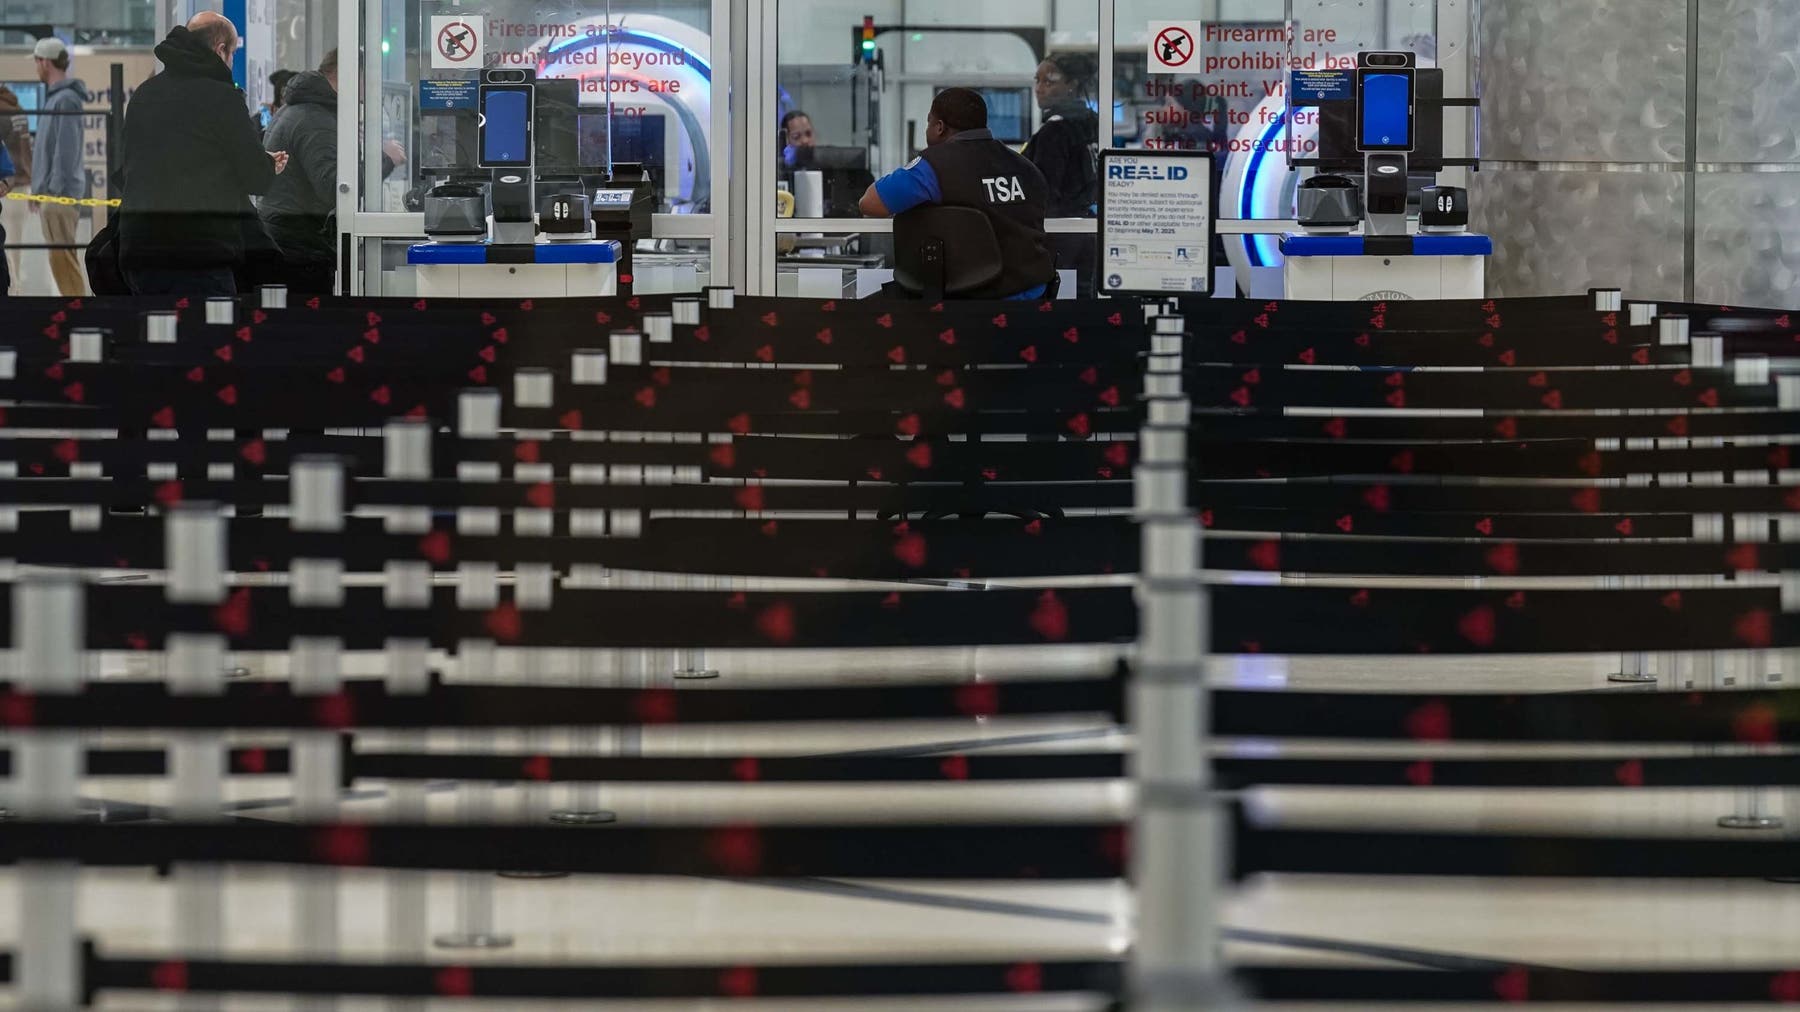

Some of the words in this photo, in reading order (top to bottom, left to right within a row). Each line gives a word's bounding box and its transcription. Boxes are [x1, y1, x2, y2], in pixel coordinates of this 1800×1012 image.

[489, 19, 577, 37] Firearms
[585, 24, 619, 36] are
[1303, 28, 1336, 42] are
[491, 46, 597, 67] prohibited
[608, 47, 685, 70] beyond
[1206, 51, 1315, 73] prohibied
[648, 79, 681, 93] are
[1145, 79, 1183, 97] this
[1193, 79, 1254, 103] point.
[1145, 105, 1219, 129] subject
[1228, 108, 1250, 125] to
[1144, 136, 1197, 150] state
[1206, 134, 1317, 153] prosecutio
[1108, 165, 1165, 180] REAL
[1167, 166, 1188, 180] ID
[982, 176, 1026, 202] TSA
